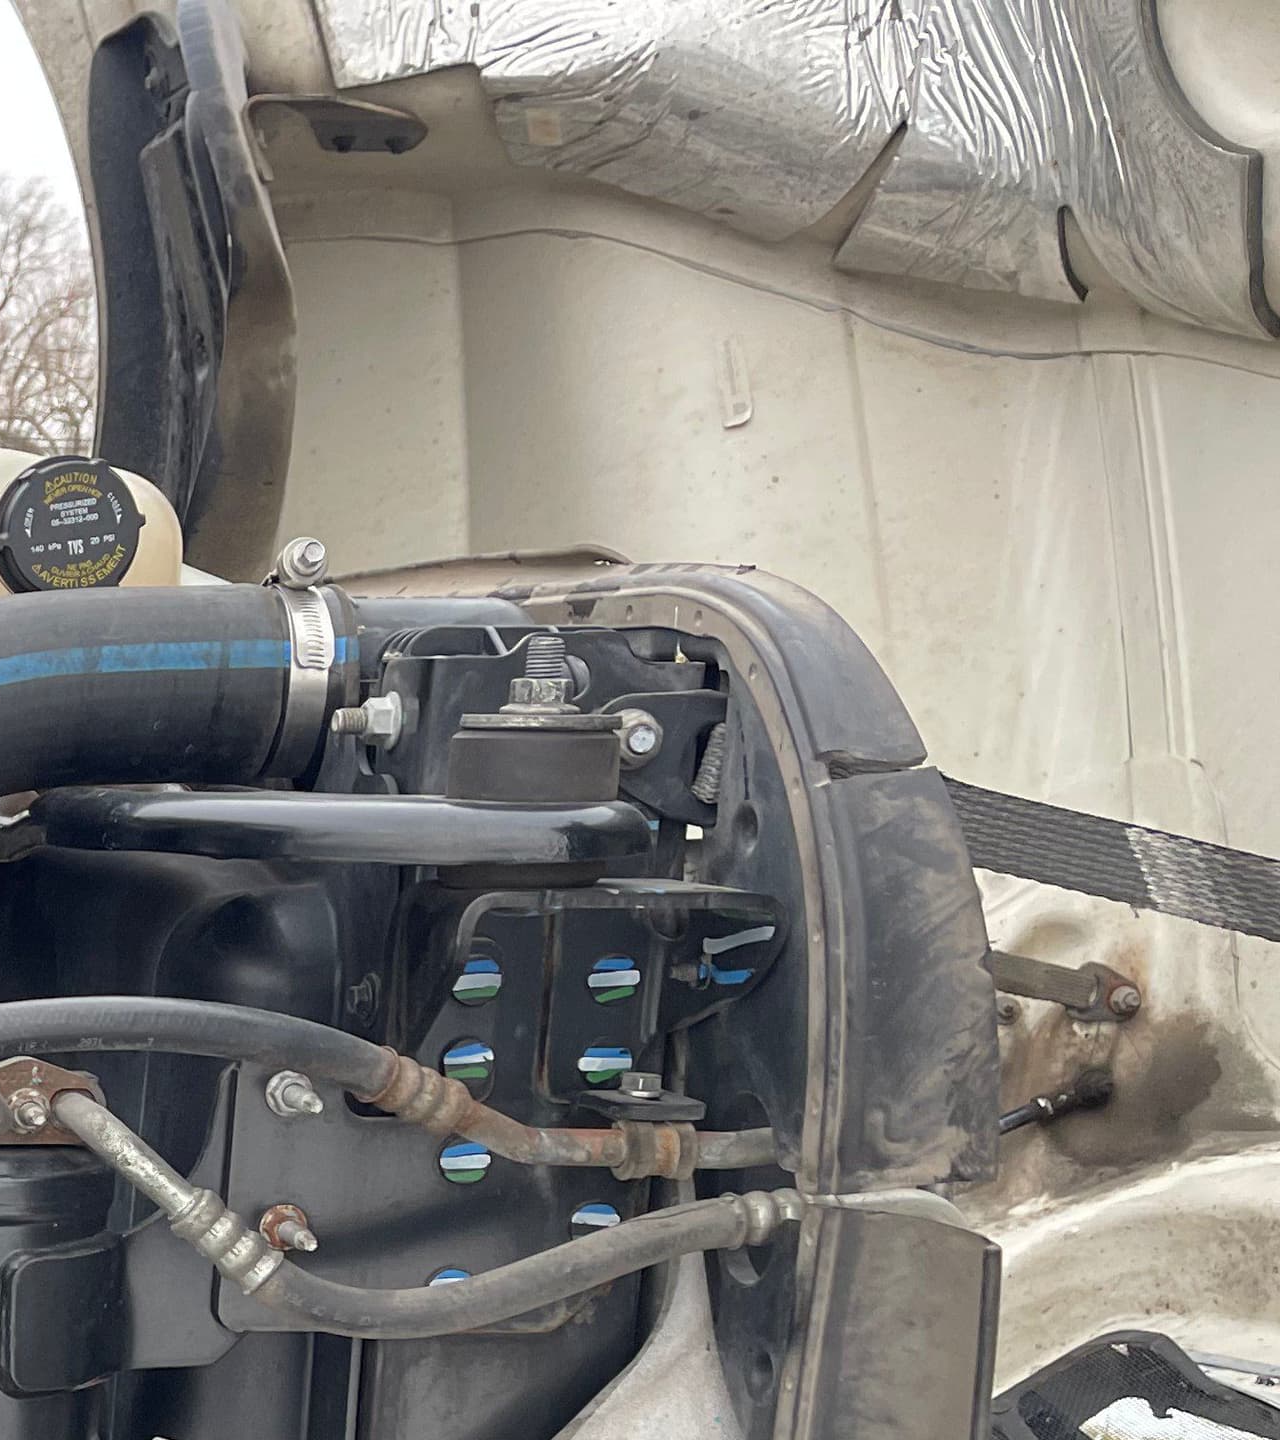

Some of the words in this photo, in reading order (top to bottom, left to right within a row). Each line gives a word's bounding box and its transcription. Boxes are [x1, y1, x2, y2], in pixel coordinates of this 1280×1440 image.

[53, 472, 98, 487] CAUTION
[50, 497, 97, 511] PRESSURIZED
[60, 507, 88, 518] SYSTEM
[67, 538, 84, 556] TVS
[103, 533, 116, 543] PSI
